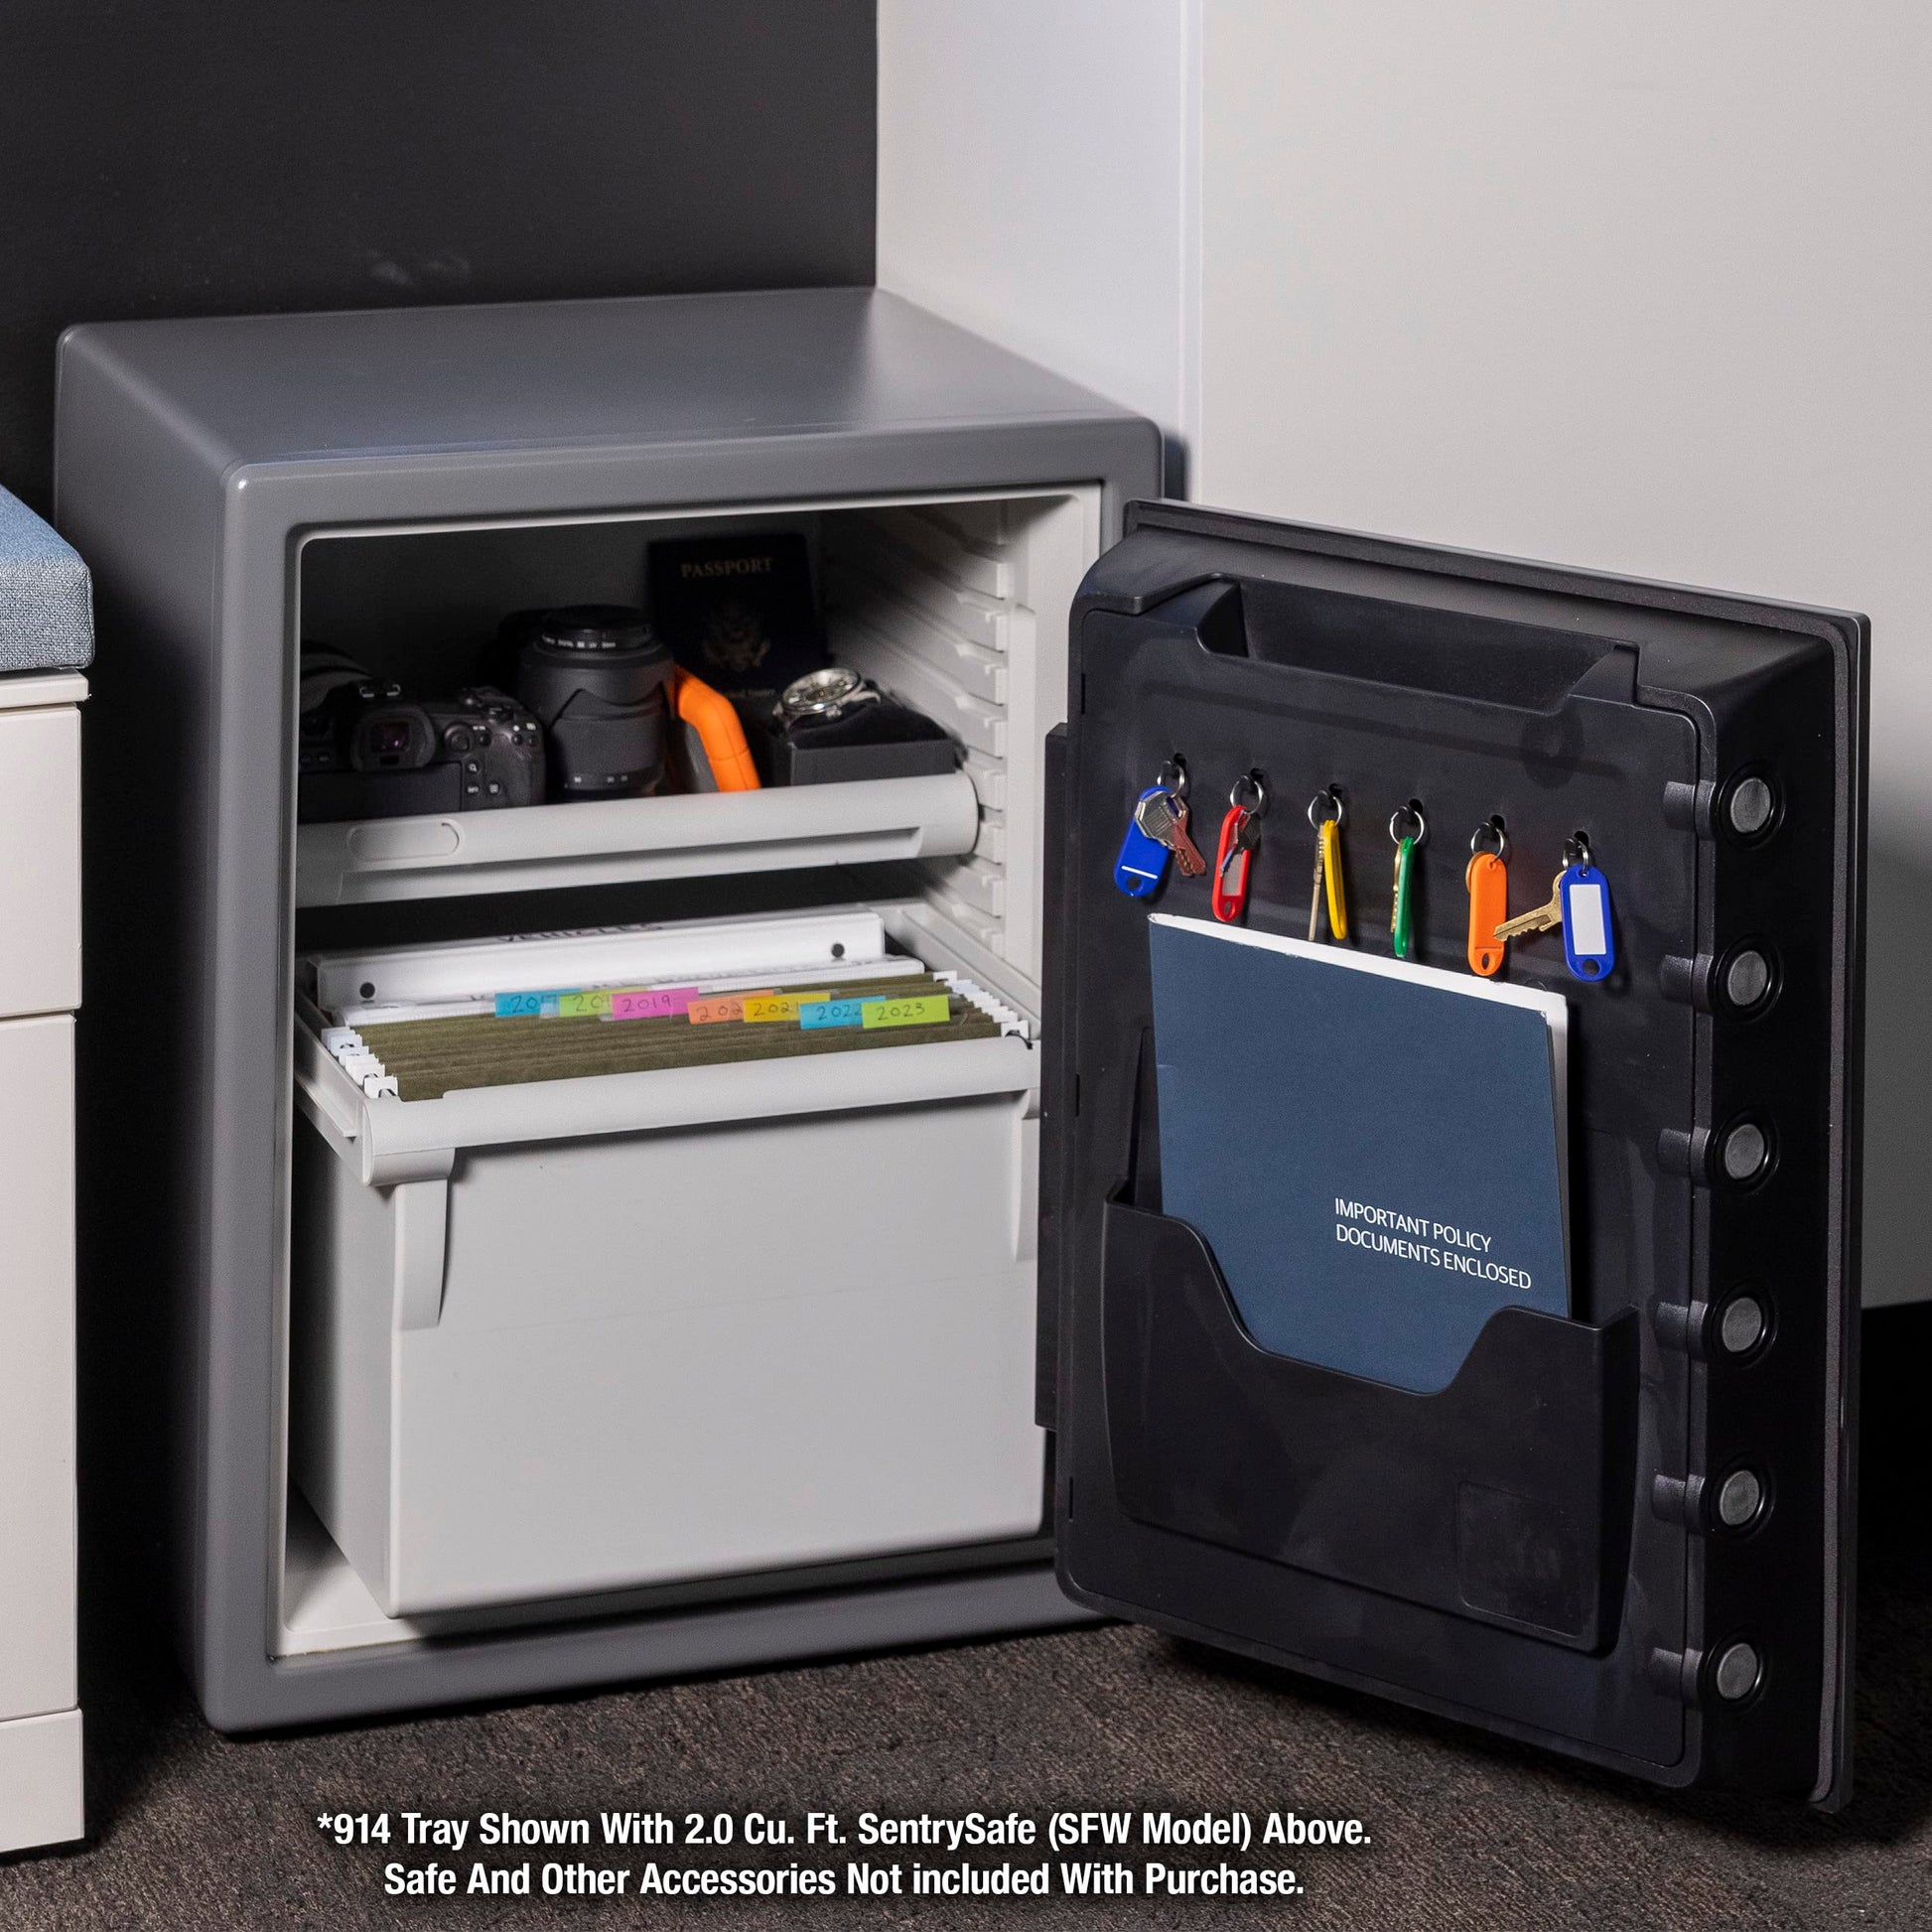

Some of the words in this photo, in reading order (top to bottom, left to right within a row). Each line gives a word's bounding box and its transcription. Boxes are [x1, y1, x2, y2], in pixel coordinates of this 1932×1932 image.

[680, 557, 773, 578] PASSPORT
[621, 994, 672, 1013] 2019
[696, 1002, 743, 1022] 202
[876, 1002, 925, 1021] 2023
[1334, 1197, 1430, 1237] IMPORTANT
[1433, 1222, 1492, 1253] POLICY
[1335, 1223, 1441, 1267] DOCUMENTS
[1444, 1251, 1532, 1290] ENCLOSED
